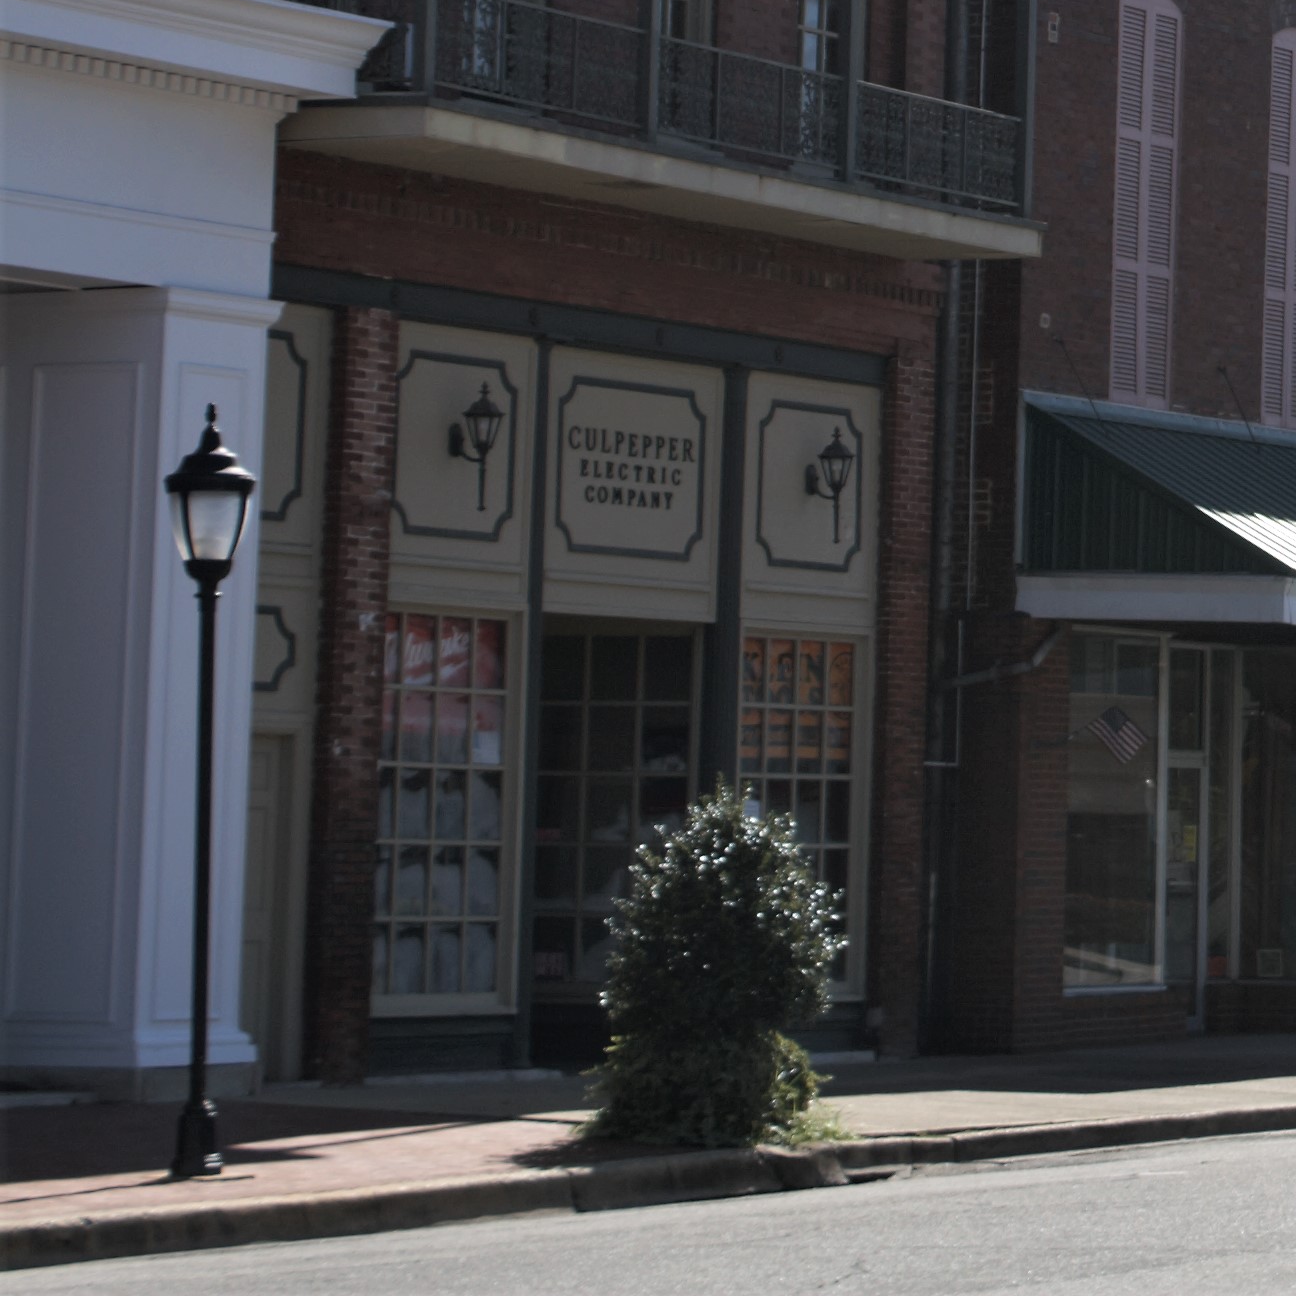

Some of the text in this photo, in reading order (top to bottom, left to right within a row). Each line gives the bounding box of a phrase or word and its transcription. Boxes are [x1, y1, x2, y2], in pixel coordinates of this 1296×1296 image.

[567, 425, 696, 463] CULPEPPER
[579, 458, 682, 487] ELECTRIC
[584, 485, 674, 510] COMPANY
